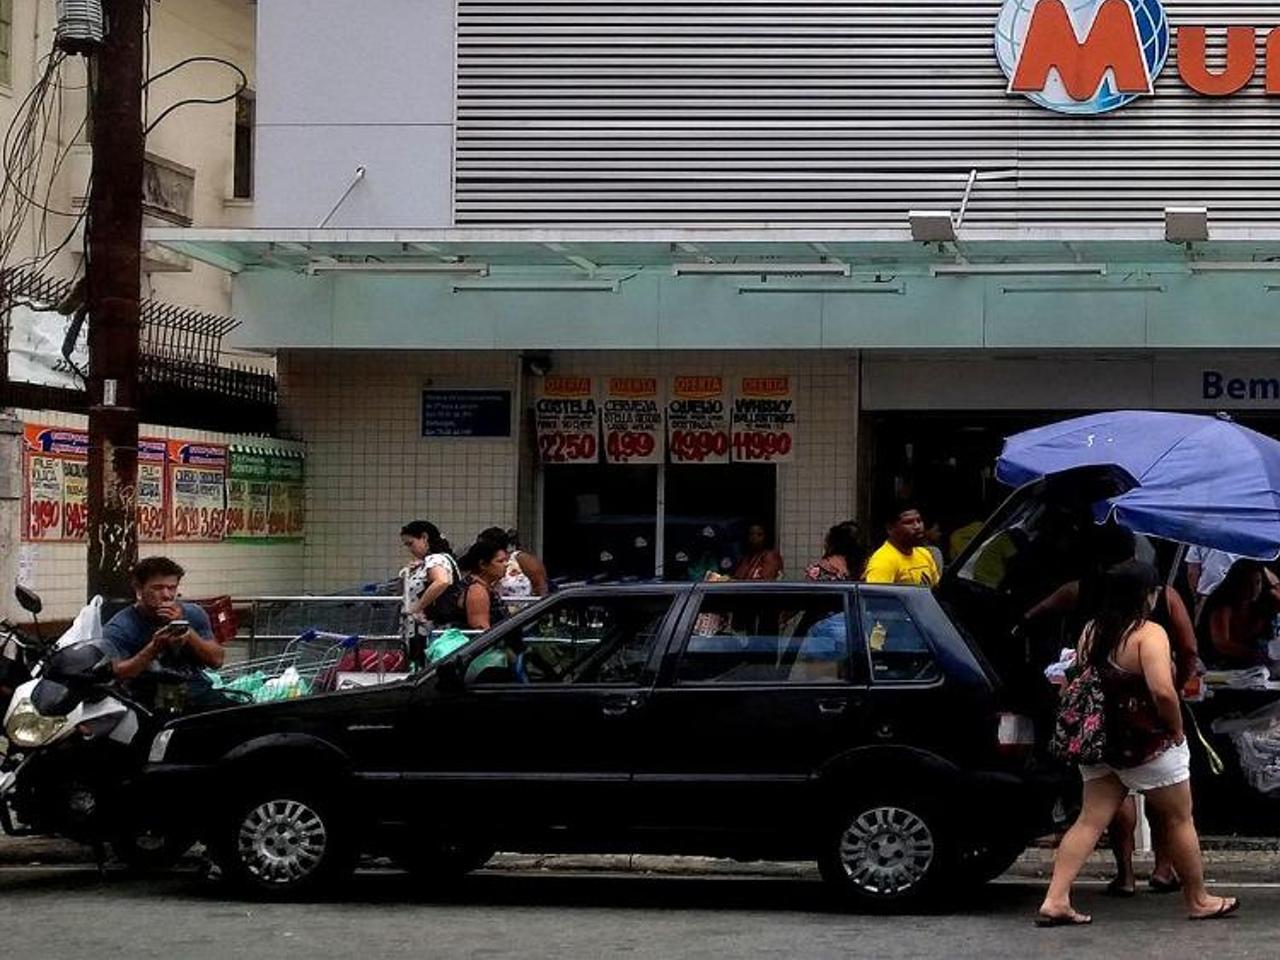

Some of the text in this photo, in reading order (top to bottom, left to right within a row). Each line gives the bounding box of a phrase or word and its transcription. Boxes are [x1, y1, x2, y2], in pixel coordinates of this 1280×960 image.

[1202, 370, 1280, 399] Bem
[605, 400, 657, 412] CERVEJA
[670, 400, 722, 413] QUEIJO
[735, 400, 792, 412] WHISKY
